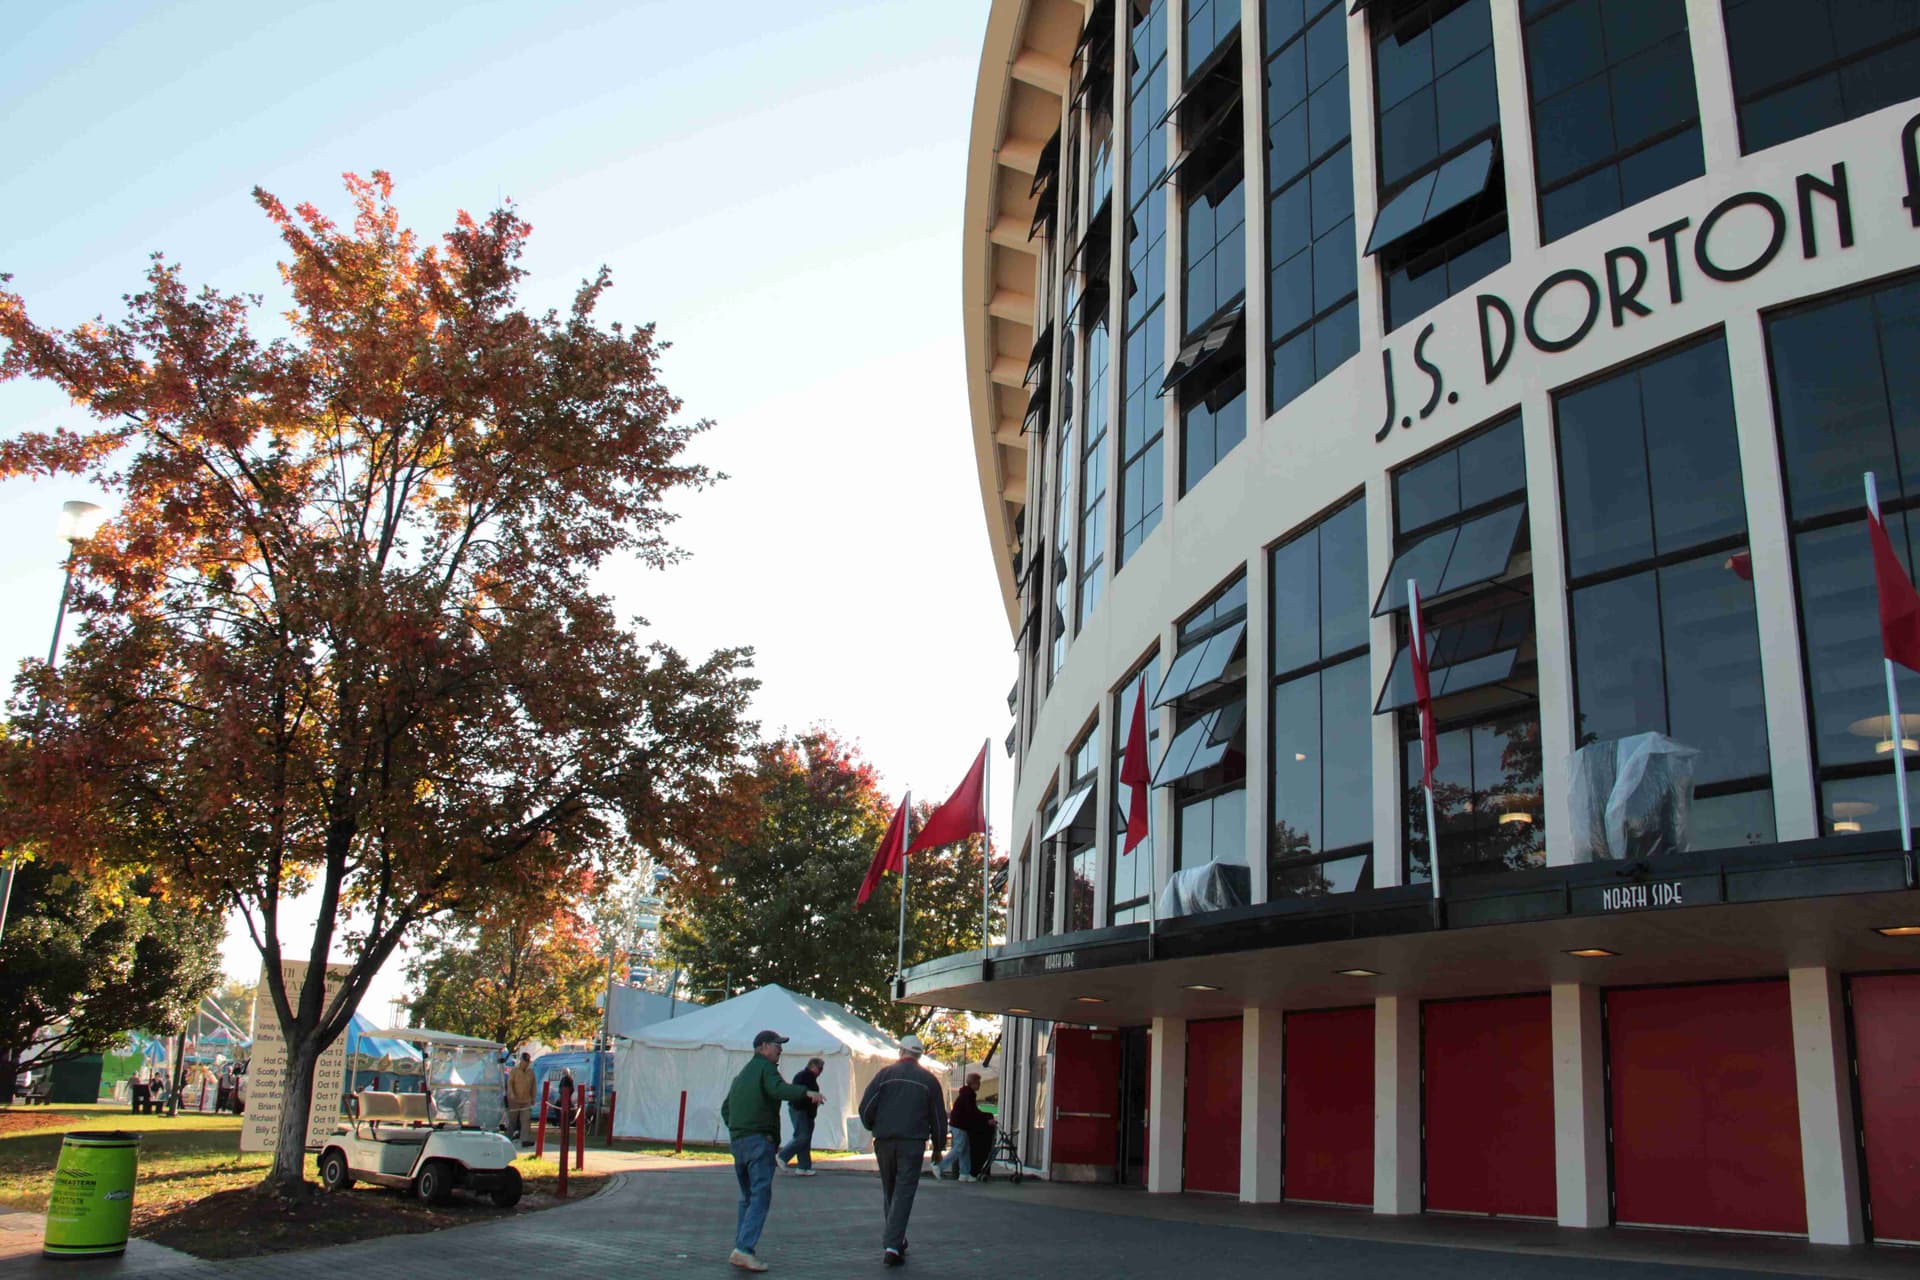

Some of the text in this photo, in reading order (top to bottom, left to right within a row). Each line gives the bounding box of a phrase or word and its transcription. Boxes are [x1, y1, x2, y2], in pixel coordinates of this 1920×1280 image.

[1375, 323, 1458, 443] J.S.
[1476, 161, 1854, 385] DORTON
[1602, 882, 1682, 910] NORTH SIDE
[320, 1059, 332, 1067] Oct
[317, 1081, 330, 1089] Oct
[316, 1092, 328, 1100] Oct
[330, 1092, 338, 1100] 17
[315, 1103, 327, 1111] Oct
[313, 1115, 325, 1123] Oct
[312, 1127, 324, 1135] Oct
